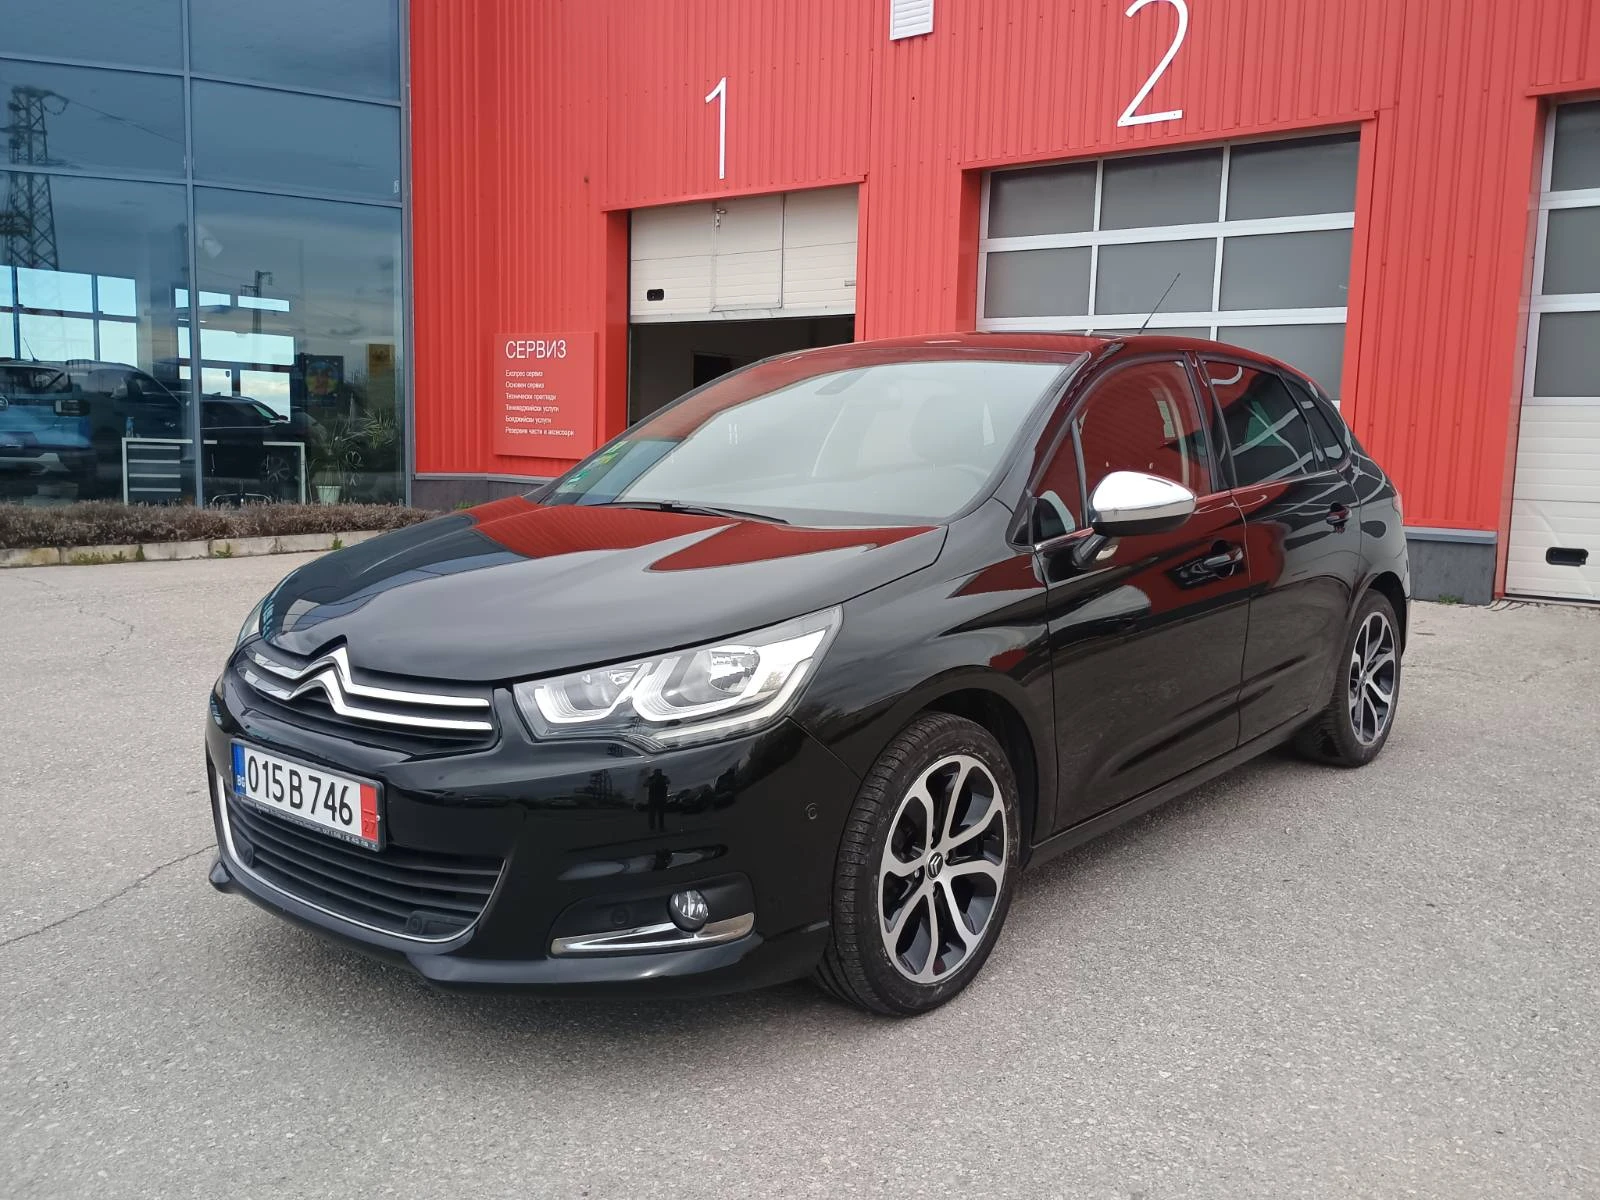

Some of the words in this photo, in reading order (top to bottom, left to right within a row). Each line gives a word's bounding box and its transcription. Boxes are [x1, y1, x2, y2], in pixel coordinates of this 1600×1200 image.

[1117, 0, 1189, 127] 2
[705, 77, 727, 180] 1
[505, 339, 567, 359] СЕРВИЗ
[526, 370, 543, 378] сервиз
[543, 405, 559, 413] услуги
[535, 416, 552, 424] услуги
[247, 755, 353, 826] 015B746
